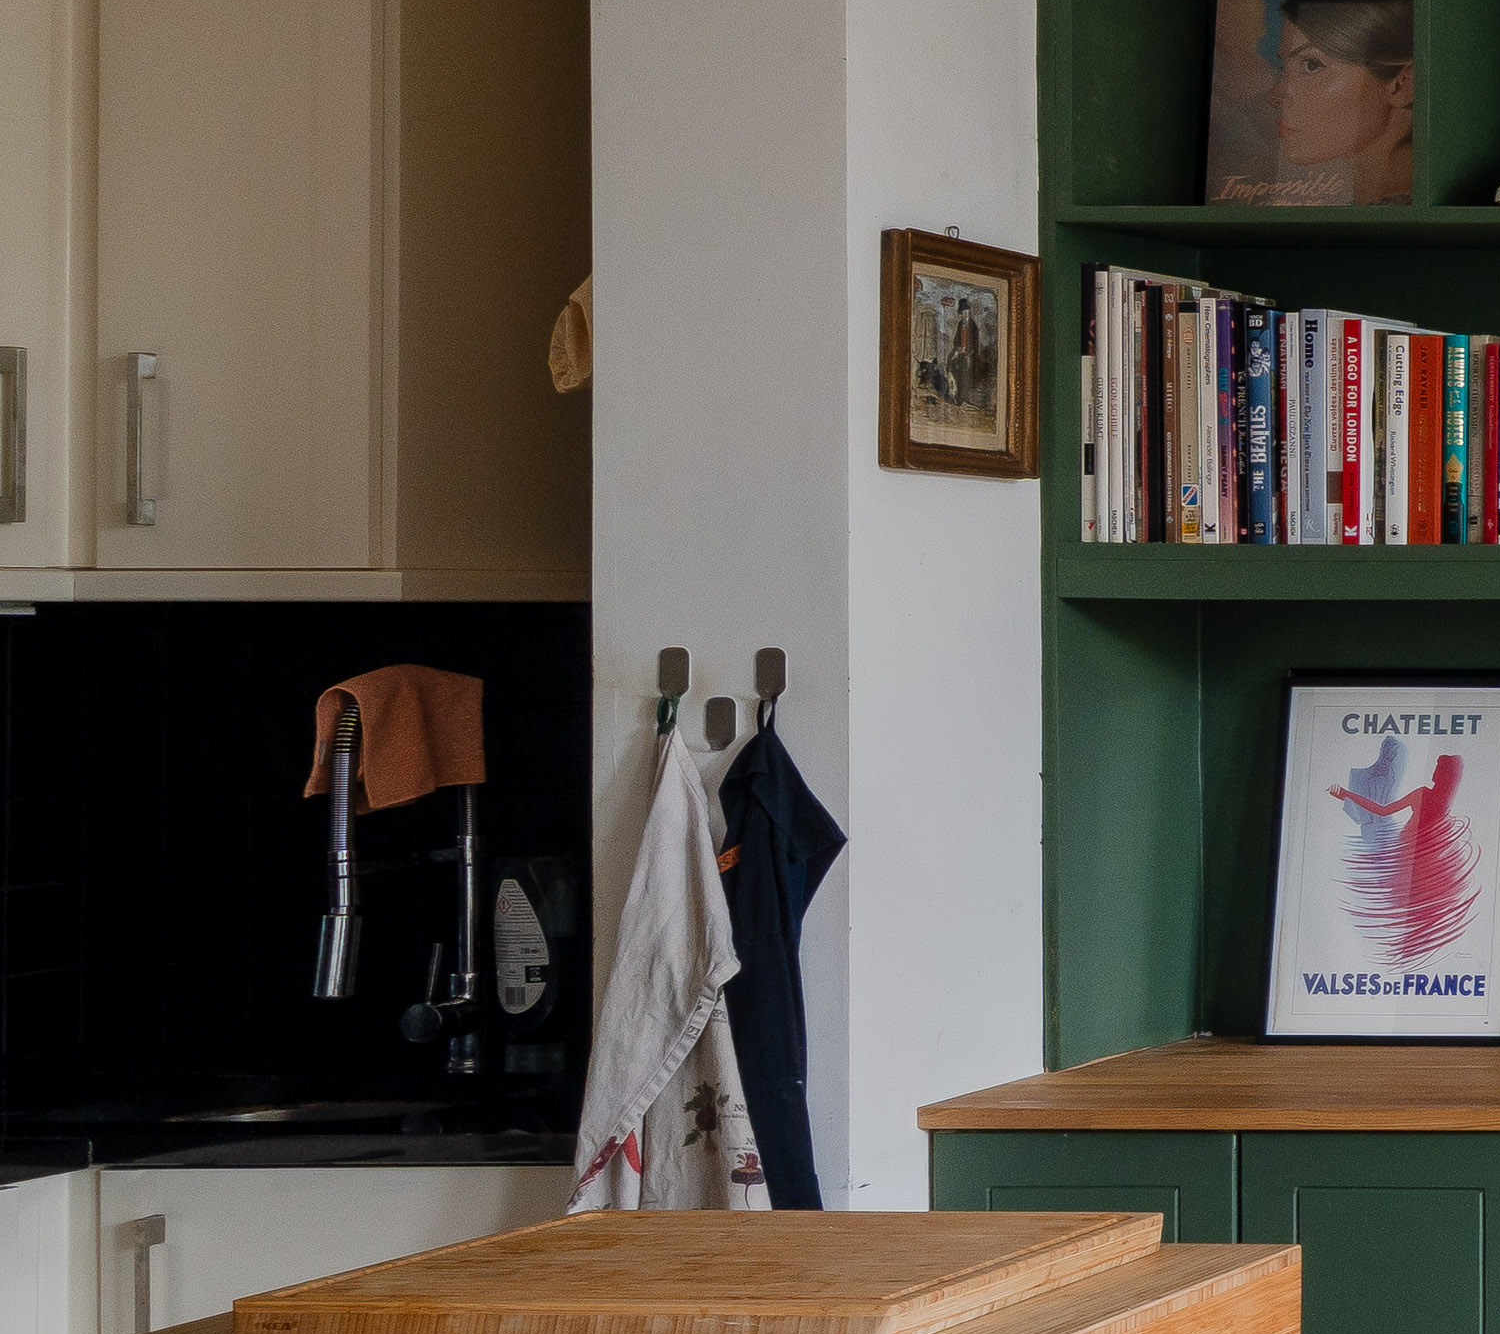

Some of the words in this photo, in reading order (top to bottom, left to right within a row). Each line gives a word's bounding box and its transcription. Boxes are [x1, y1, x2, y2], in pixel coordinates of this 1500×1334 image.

[1304, 319, 1320, 369] Home
[1347, 336, 1358, 344] A
[1347, 348, 1358, 381] LOGO
[1393, 344, 1405, 386] Cutting
[1346, 385, 1358, 408] FOR
[1393, 389, 1405, 417] Edge
[1250, 404, 1267, 464] BEATLES
[1346, 411, 1357, 462] LONDON
[1252, 470, 1265, 492] THE
[1342, 713, 1482, 735] CHATELET
[1303, 973, 1382, 996] VALSES
[1383, 981, 1400, 996] DE
[1403, 974, 1486, 996] FRANCE
